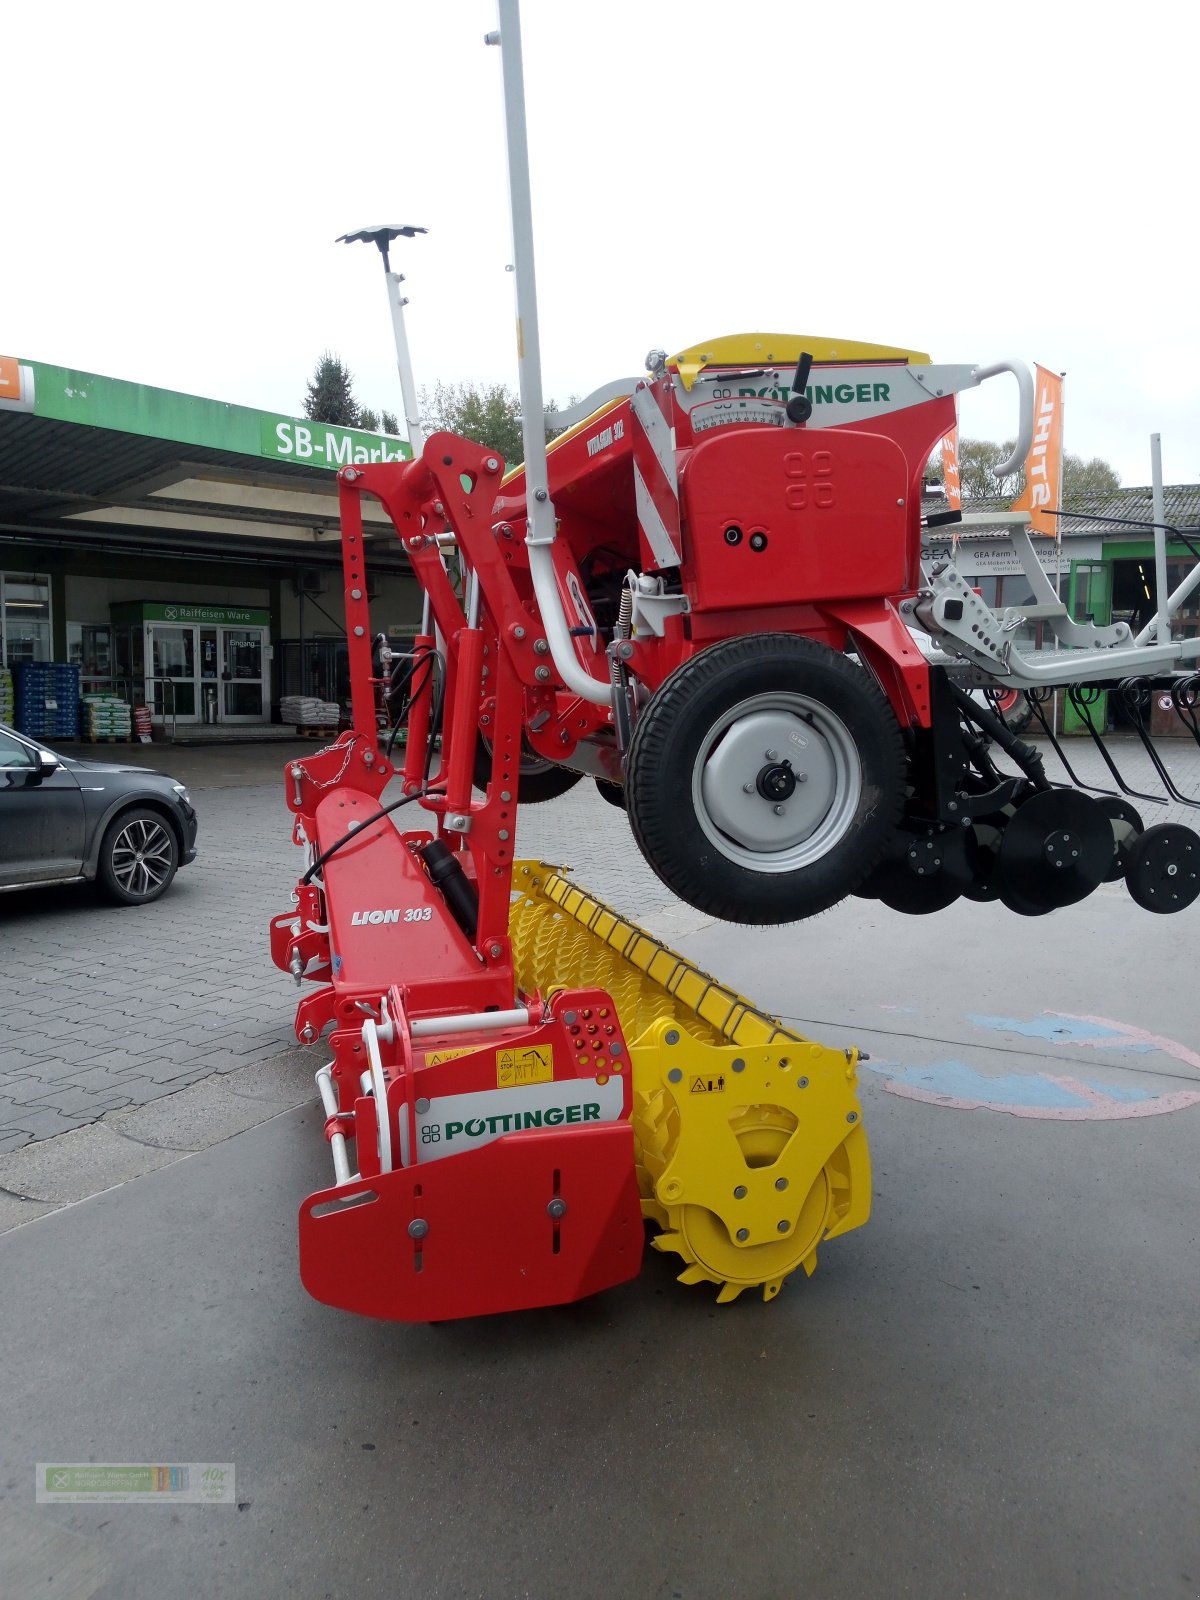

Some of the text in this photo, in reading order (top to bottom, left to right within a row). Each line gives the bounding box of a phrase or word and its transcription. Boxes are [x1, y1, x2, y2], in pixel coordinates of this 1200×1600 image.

[739, 383, 890, 407] PÖTINGER
[276, 422, 406, 464] SB-Markt
[920, 549, 952, 561] GEA
[974, 551, 990, 559] GEA
[992, 550, 1011, 558] Farm
[180, 608, 225, 619] Raiffeisen
[227, 611, 251, 620] Ware
[229, 640, 255, 649] Eingang
[351, 907, 432, 926] LION 303
[445, 1102, 601, 1140] PÖTTINGER
